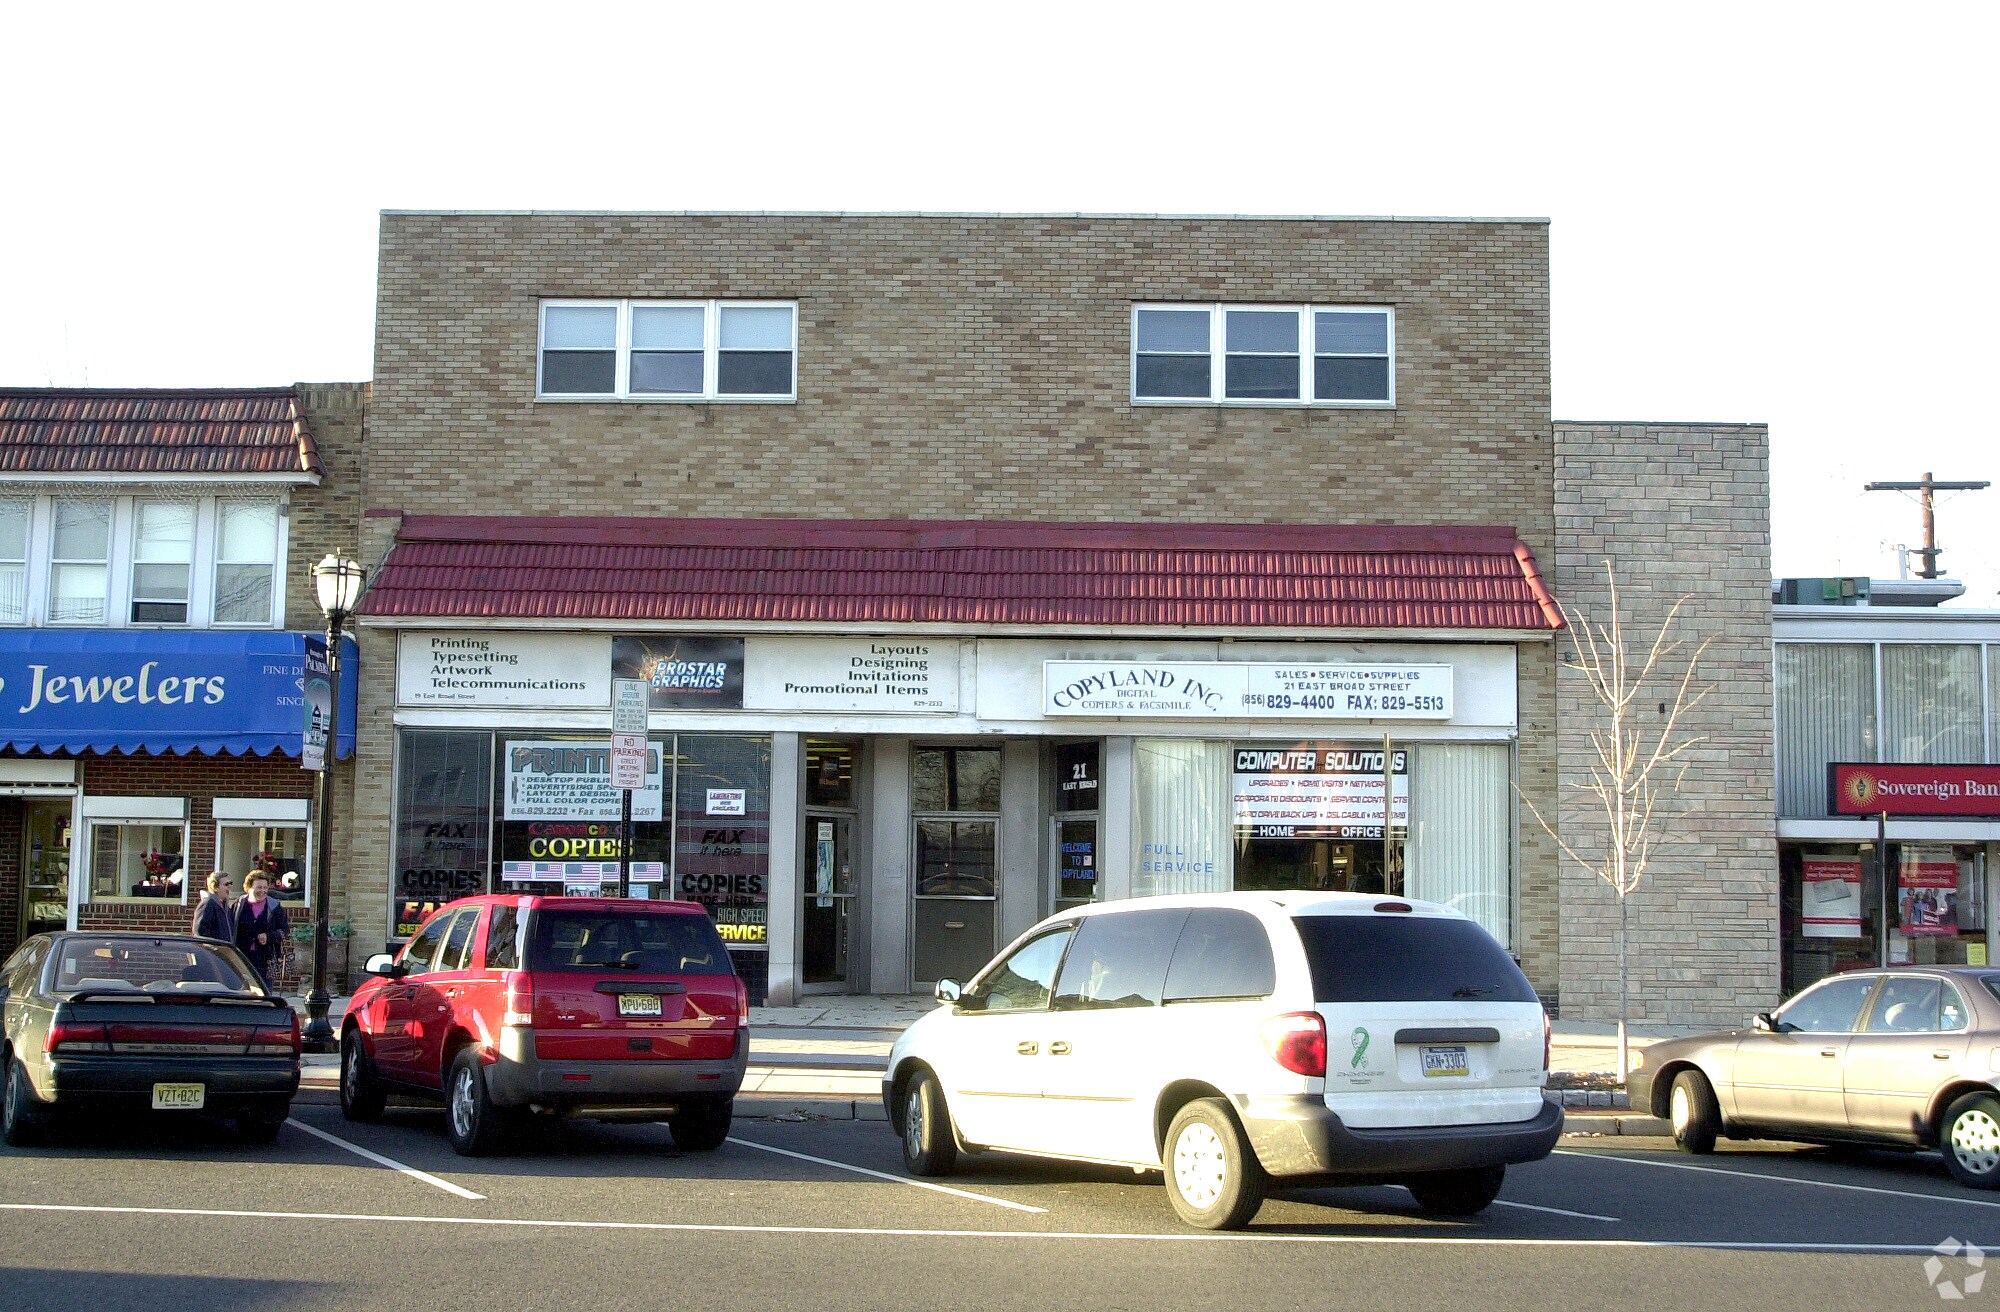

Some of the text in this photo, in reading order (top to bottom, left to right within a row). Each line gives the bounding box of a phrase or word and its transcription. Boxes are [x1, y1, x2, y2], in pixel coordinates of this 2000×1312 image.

[431, 637, 490, 651] Printing
[871, 643, 929, 657] Layouts
[432, 651, 518, 665] Typesetting
[851, 657, 928, 671] Designing
[263, 666, 288, 675] FINE
[655, 662, 727, 677] PROSTAR
[848, 670, 928, 682] Invitations
[1274, 670, 1420, 680] SALES SERVICE SUPPLIES
[18, 661, 226, 714] Jewelers
[431, 677, 586, 690] Telecommunications
[651, 675, 725, 689] GRAPHICS
[1284, 682, 1412, 691] 21 EAST BROAD STREET
[785, 683, 929, 696] Promotional Items
[1053, 668, 1224, 711] COPYLAND INC.
[1117, 689, 1157, 698] DIGITAL
[277, 696, 304, 706] SINC
[1082, 701, 1124, 709] COPIERS
[1139, 702, 1192, 710] FACSIMILE
[1241, 693, 1444, 710] (856) 829-4400 FAX: 829-5513
[624, 738, 635, 747] NO
[613, 747, 645, 758] PARKING
[510, 747, 659, 776] PRINTI
[1236, 751, 1317, 771] COMPUTER
[1072, 763, 1087, 779] 21
[526, 783, 594, 791] ADVERTISING
[1350, 780, 1386, 788] NETWOR
[1877, 779, 1961, 801] Sovereign
[1361, 796, 1408, 804] CONTCTS
[424, 823, 469, 838] FAX
[702, 829, 745, 845] FAX
[1259, 825, 1382, 838] HOME OFFICE
[1144, 844, 1184, 855] FULL
[1143, 862, 1214, 873] SERVICE
[402, 869, 482, 889] COPIES
[681, 873, 762, 895] COPIES
[717, 908, 767, 924] HIGH SPEED
[715, 924, 767, 941] ERVICE
